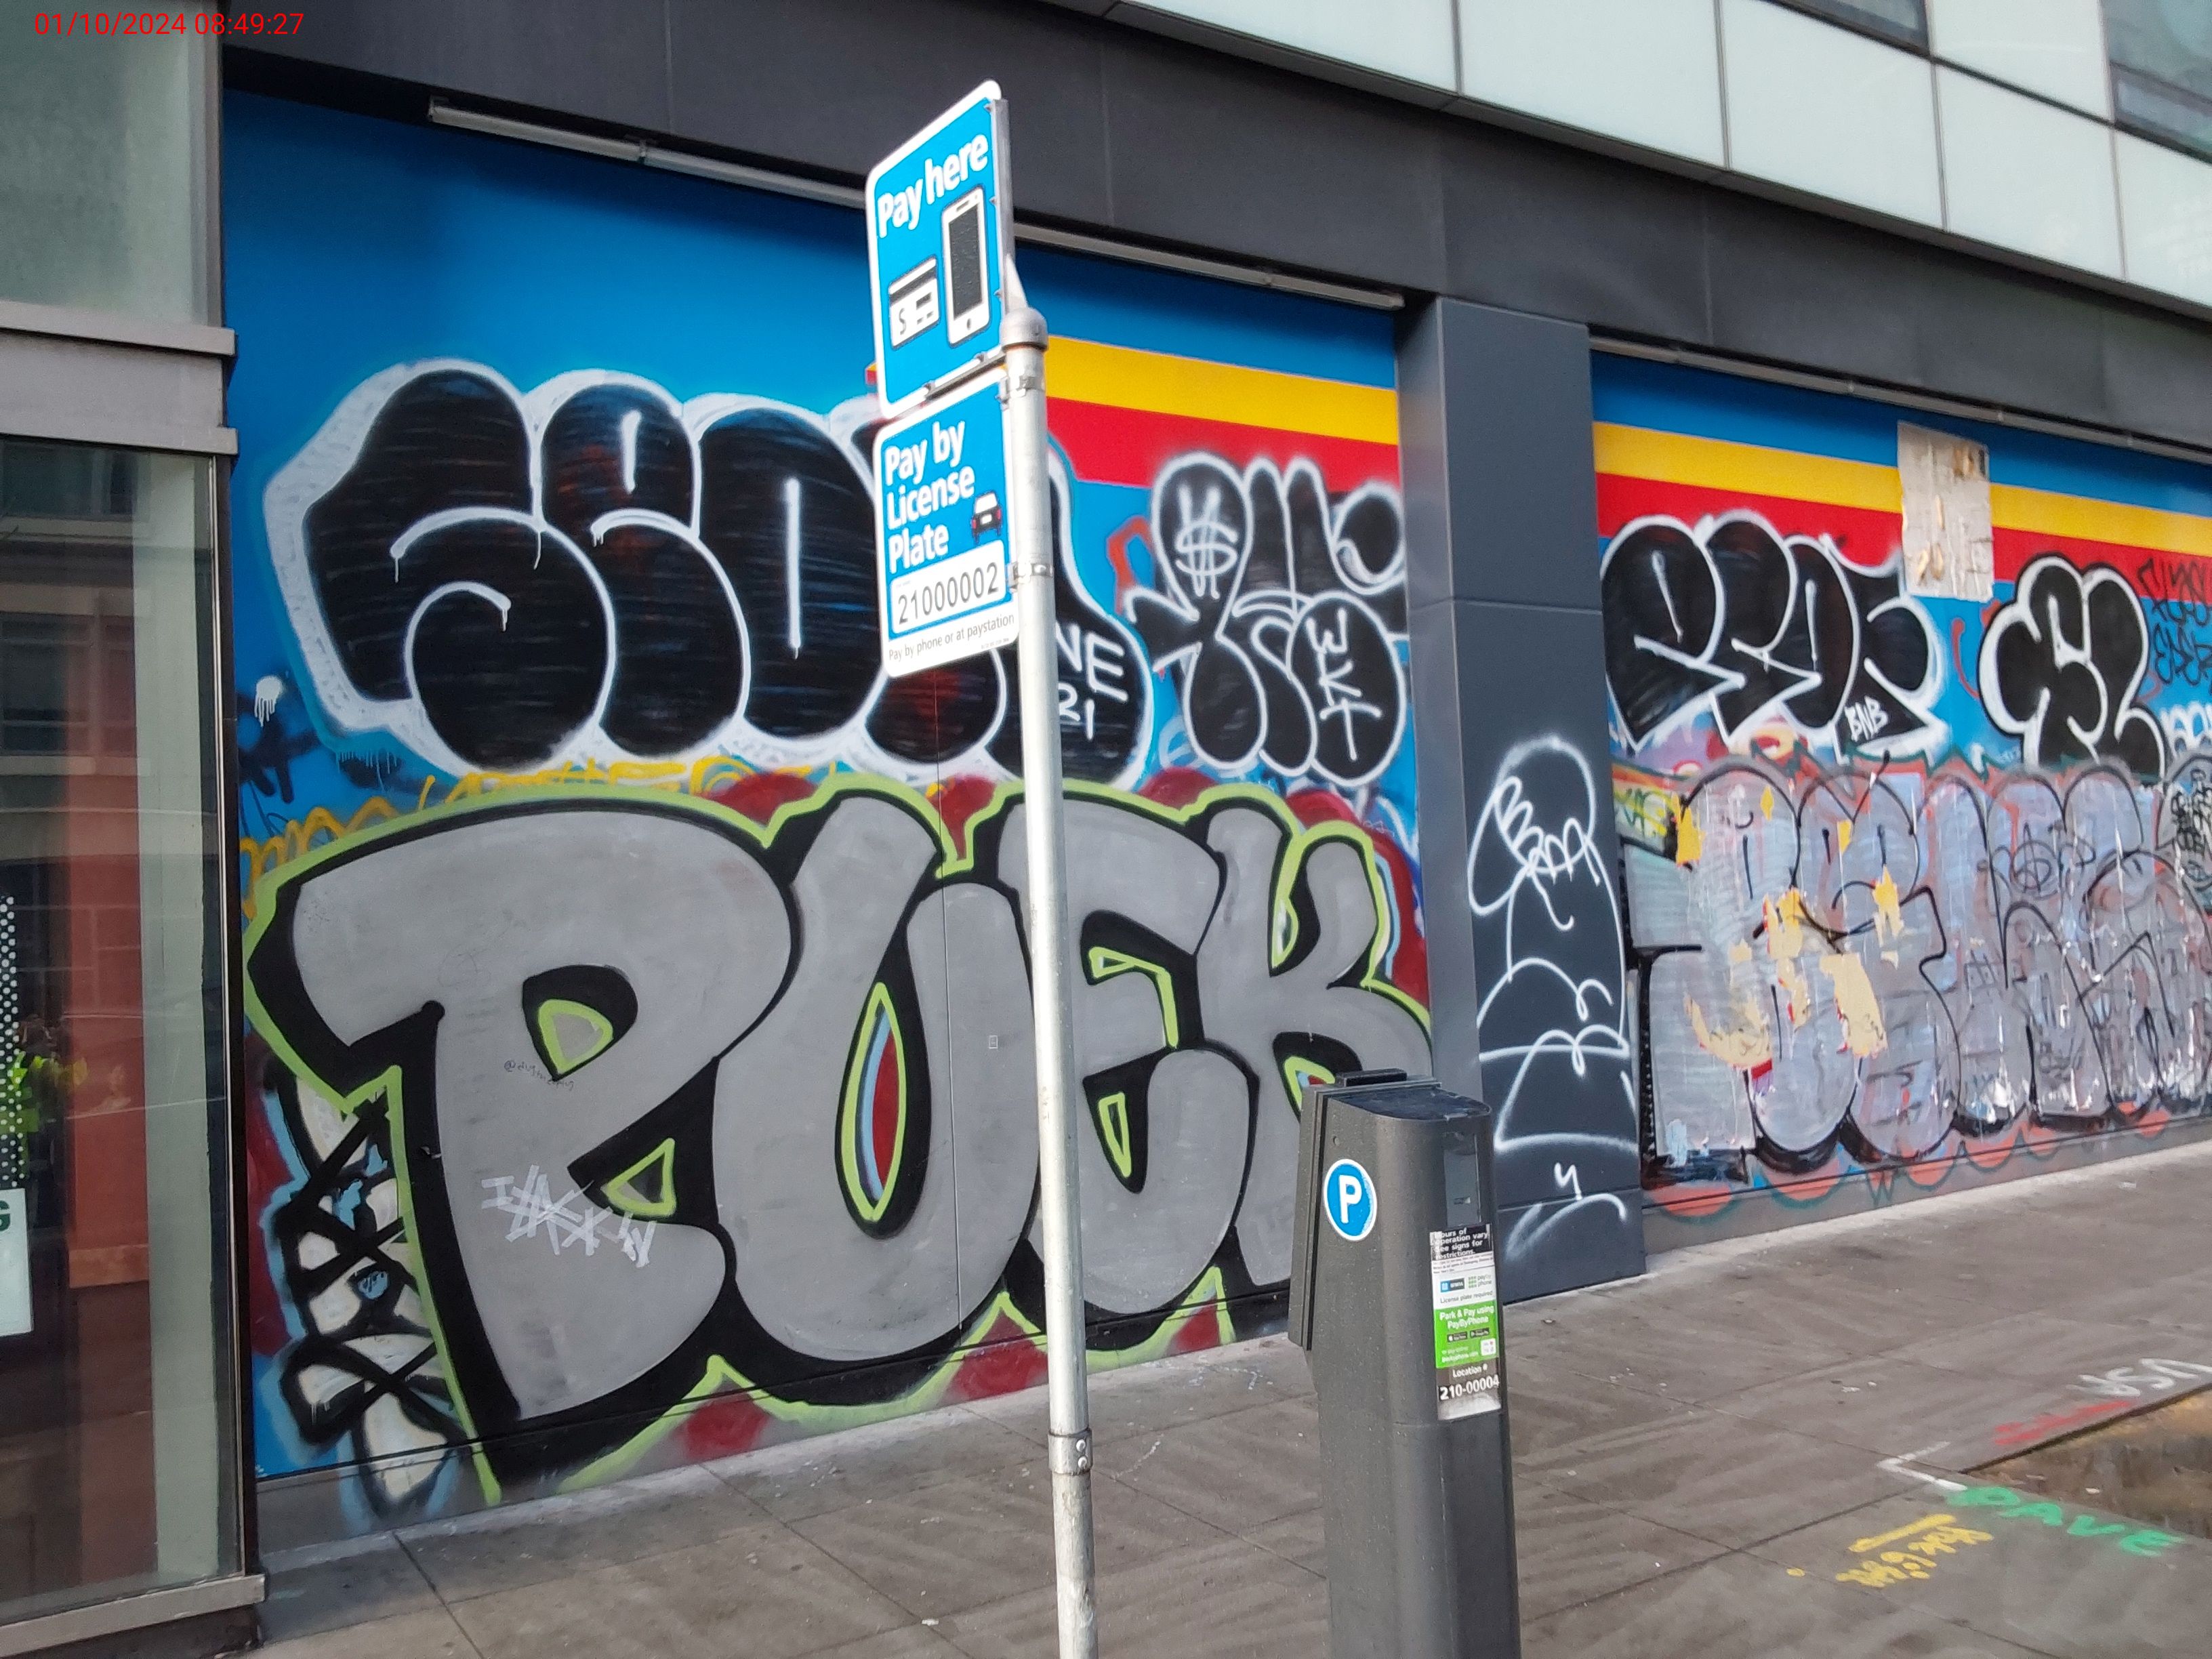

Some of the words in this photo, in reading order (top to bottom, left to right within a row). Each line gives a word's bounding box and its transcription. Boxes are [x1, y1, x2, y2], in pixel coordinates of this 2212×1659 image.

[877, 177, 924, 239] Pay
[924, 134, 989, 205] here
[884, 438, 928, 487] Pay
[932, 419, 966, 468] by
[886, 466, 976, 531] License
[887, 523, 949, 575] Plate
[898, 561, 1000, 626] 21000002
[888, 649, 903, 662] Pay
[905, 644, 914, 657] by
[916, 635, 943, 656] phone
[945, 633, 954, 644] or
[956, 628, 965, 641] at
[967, 613, 1015, 641] paystation
[1338, 1174, 1363, 1224] P
[1452, 1242, 1470, 1251] signs
[1439, 1311, 1456, 1322] Park
[1463, 1307, 1476, 1317] Pay
[1477, 1305, 1494, 1314] using
[1439, 1374, 1500, 1401] 210-00004
[1452, 1365, 1482, 1378] Location
